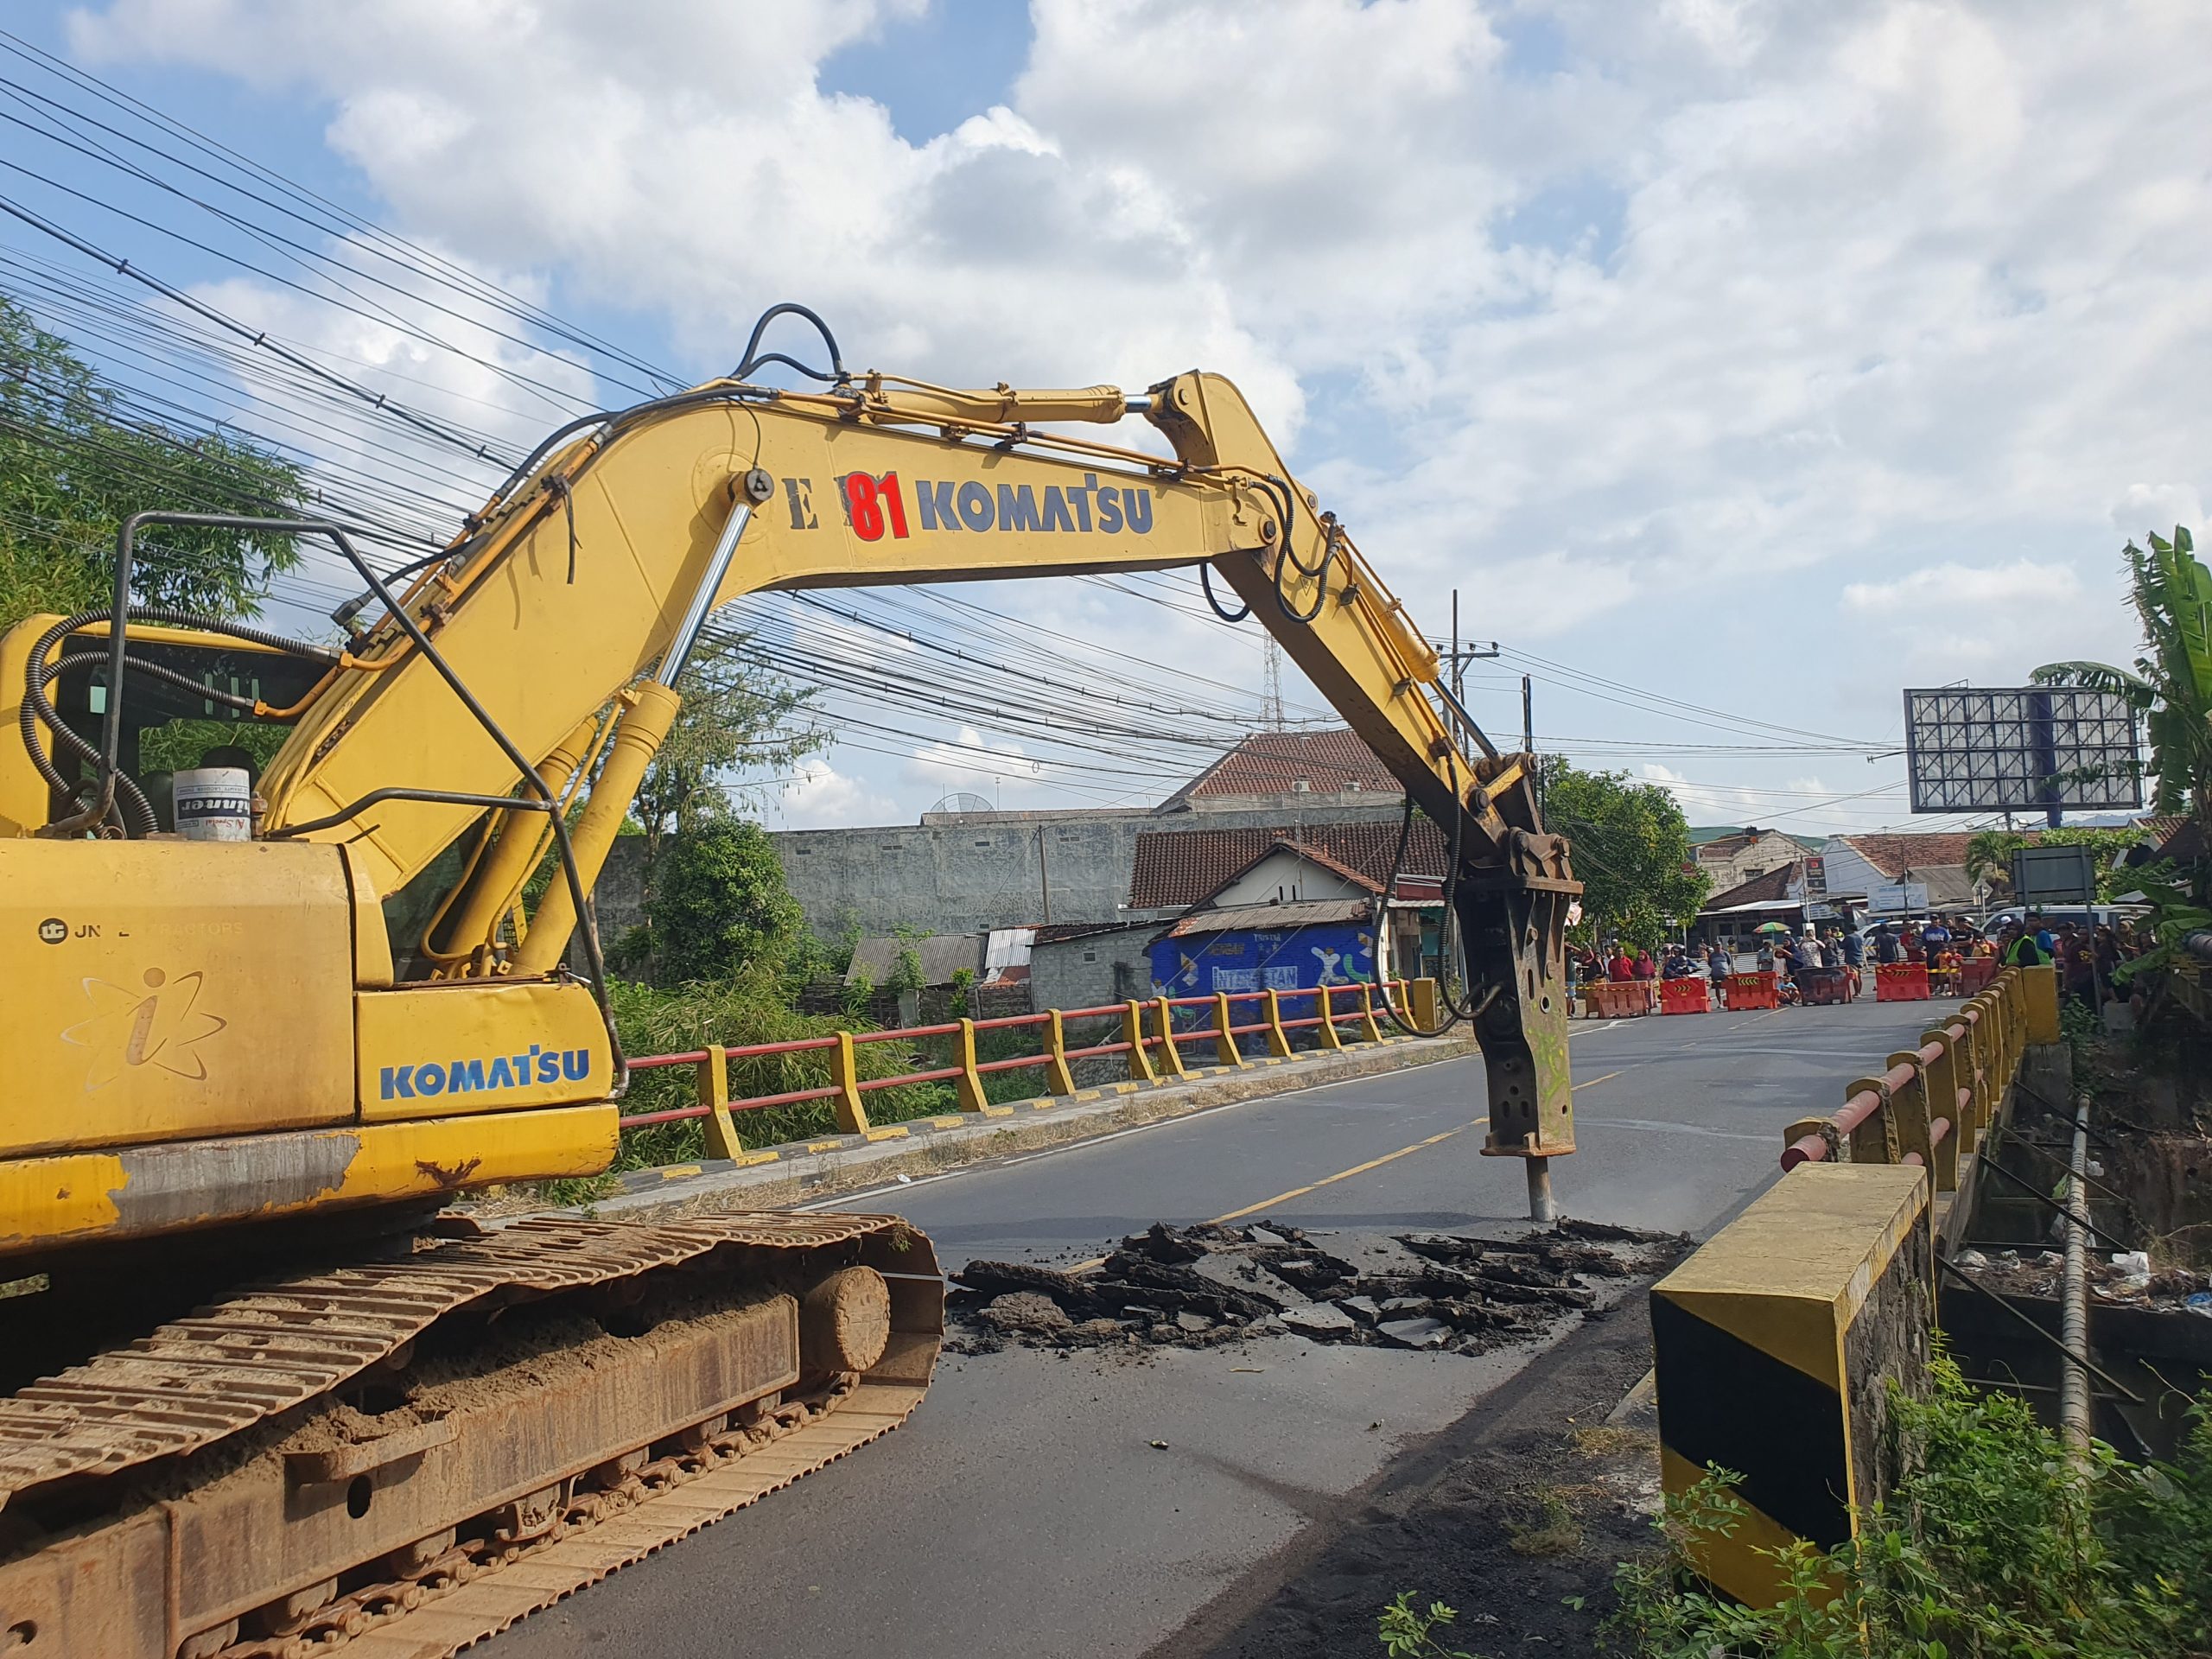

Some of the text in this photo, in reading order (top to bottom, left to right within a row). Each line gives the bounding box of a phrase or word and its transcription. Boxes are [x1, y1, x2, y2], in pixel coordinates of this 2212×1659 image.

[844, 470, 910, 542] 81
[915, 473, 1154, 534] KOMATSU
[379, 1043, 590, 1101] KOMATSU
